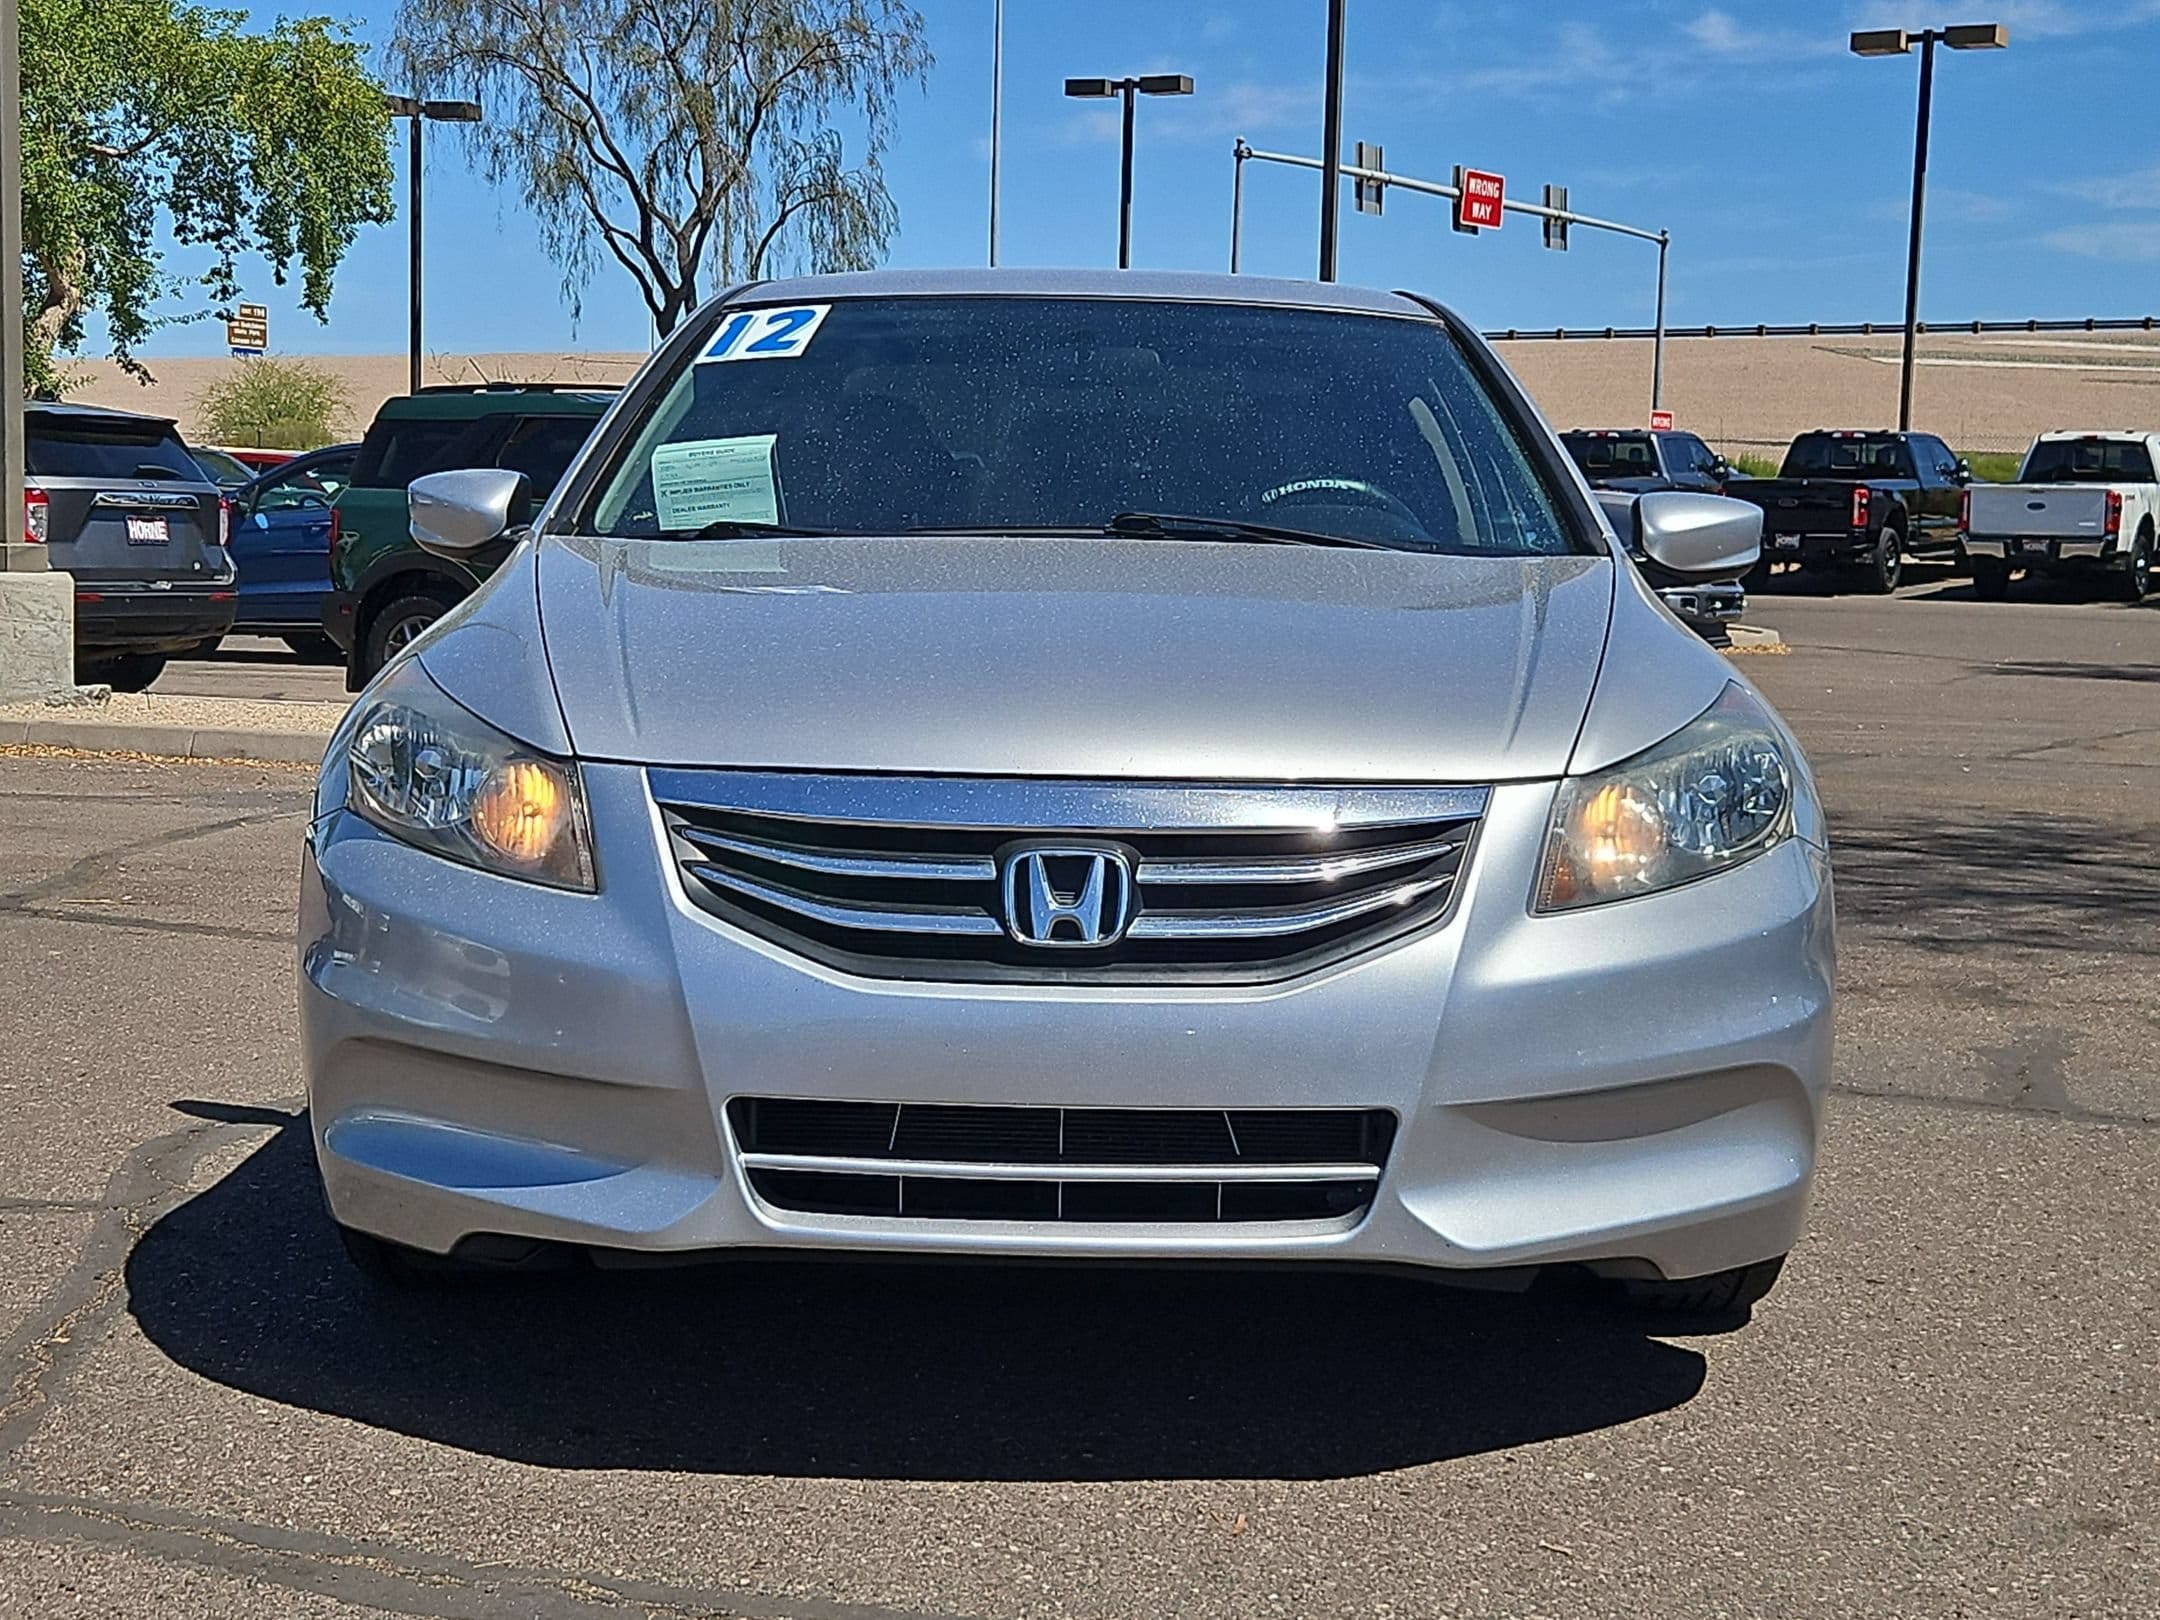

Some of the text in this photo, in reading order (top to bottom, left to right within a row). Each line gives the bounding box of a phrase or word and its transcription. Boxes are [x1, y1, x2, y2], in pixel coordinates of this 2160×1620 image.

[1469, 177, 1500, 199] WRONG
[1472, 202, 1492, 220] WAY
[704, 309, 817, 357] 12
[1279, 479, 1349, 496] HONDA
[127, 519, 170, 541] HORNE
